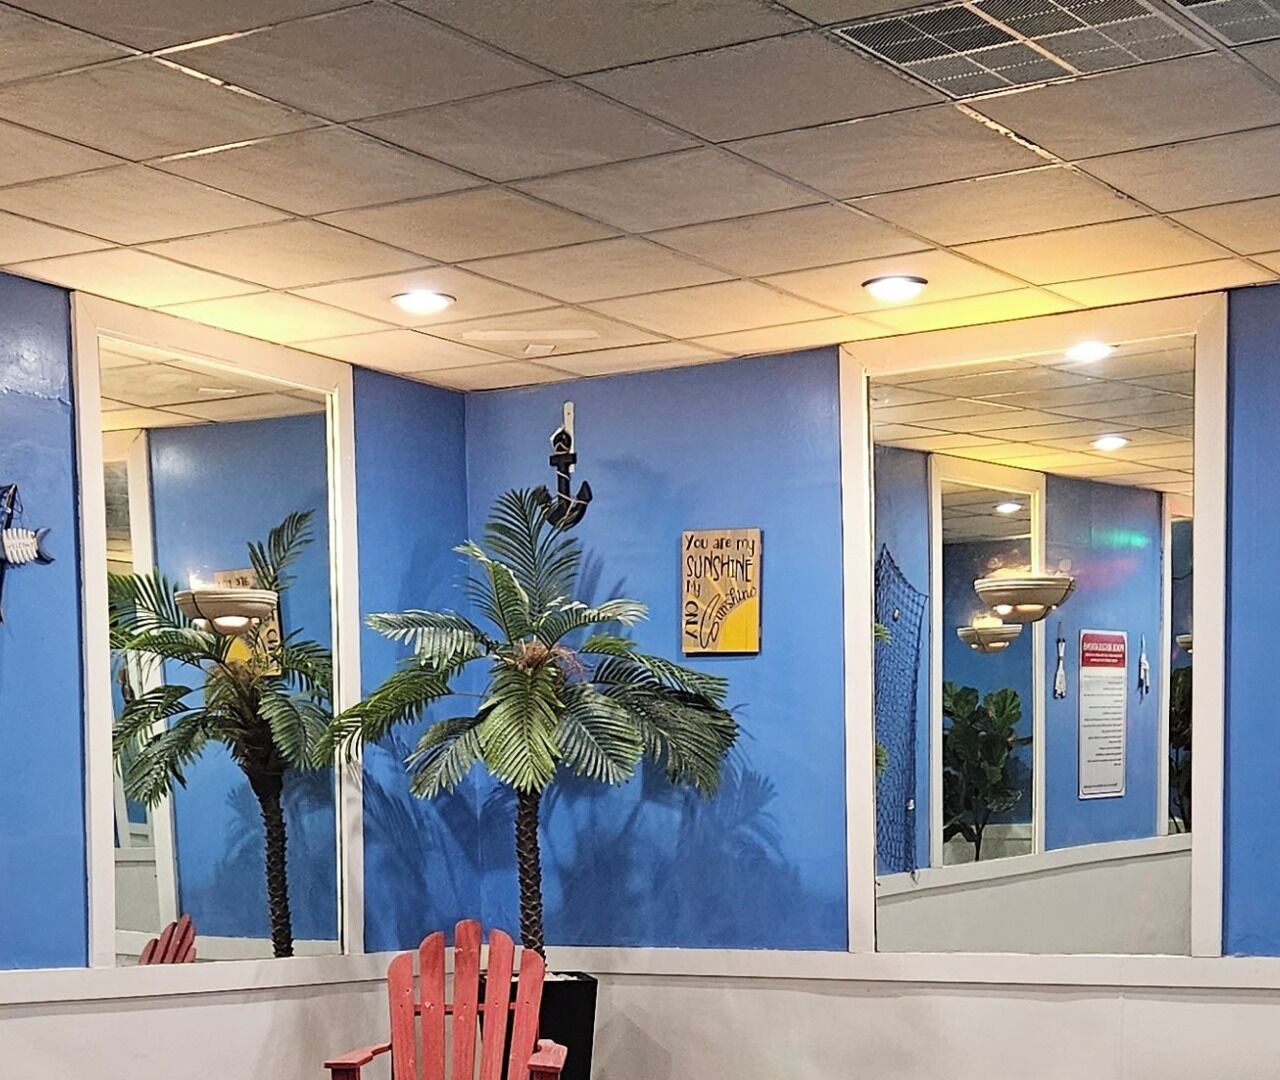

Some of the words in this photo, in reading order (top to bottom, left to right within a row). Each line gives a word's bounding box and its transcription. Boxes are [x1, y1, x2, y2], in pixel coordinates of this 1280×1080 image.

[685, 535, 708, 551] You
[713, 537, 732, 550] are
[737, 539, 755, 557] my
[686, 551, 754, 582] SUNSHINE
[686, 580, 701, 598] My
[684, 600, 699, 639] ONLY
